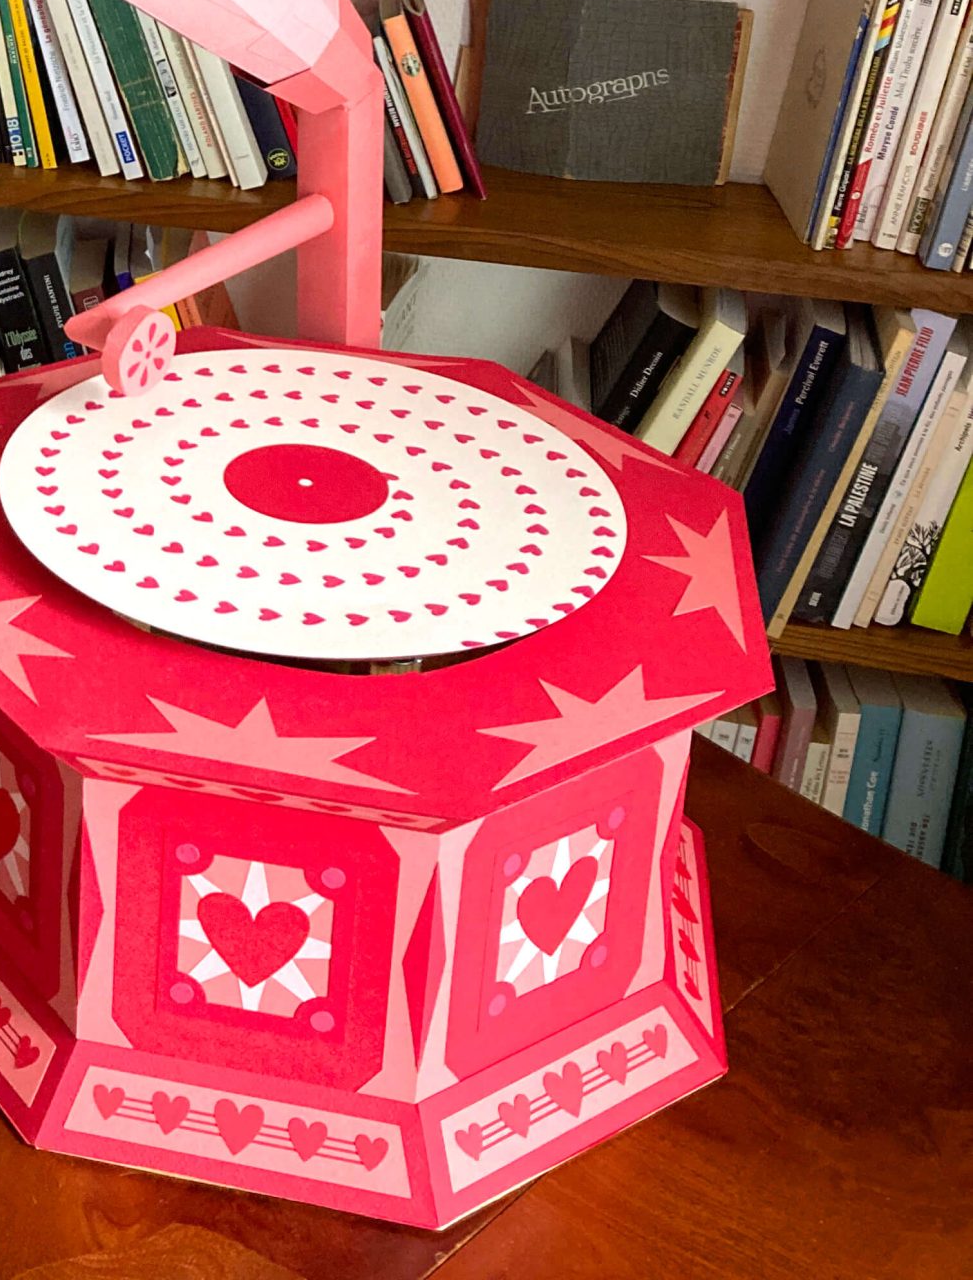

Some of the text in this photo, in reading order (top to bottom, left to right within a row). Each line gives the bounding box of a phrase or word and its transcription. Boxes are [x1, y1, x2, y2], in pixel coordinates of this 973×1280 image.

[525, 69, 670, 115] Autographs
[864, 77, 893, 153] Roméo et Juliette
[119, 133, 133, 161] POCKET
[877, 107, 899, 160] Maryse Condé
[44, 274, 65, 328] SYLVIE SANTINI
[629, 376, 648, 398] Didier
[795, 341, 829, 404] Percival Everett
[839, 462, 877, 526] LA PALESTINE
